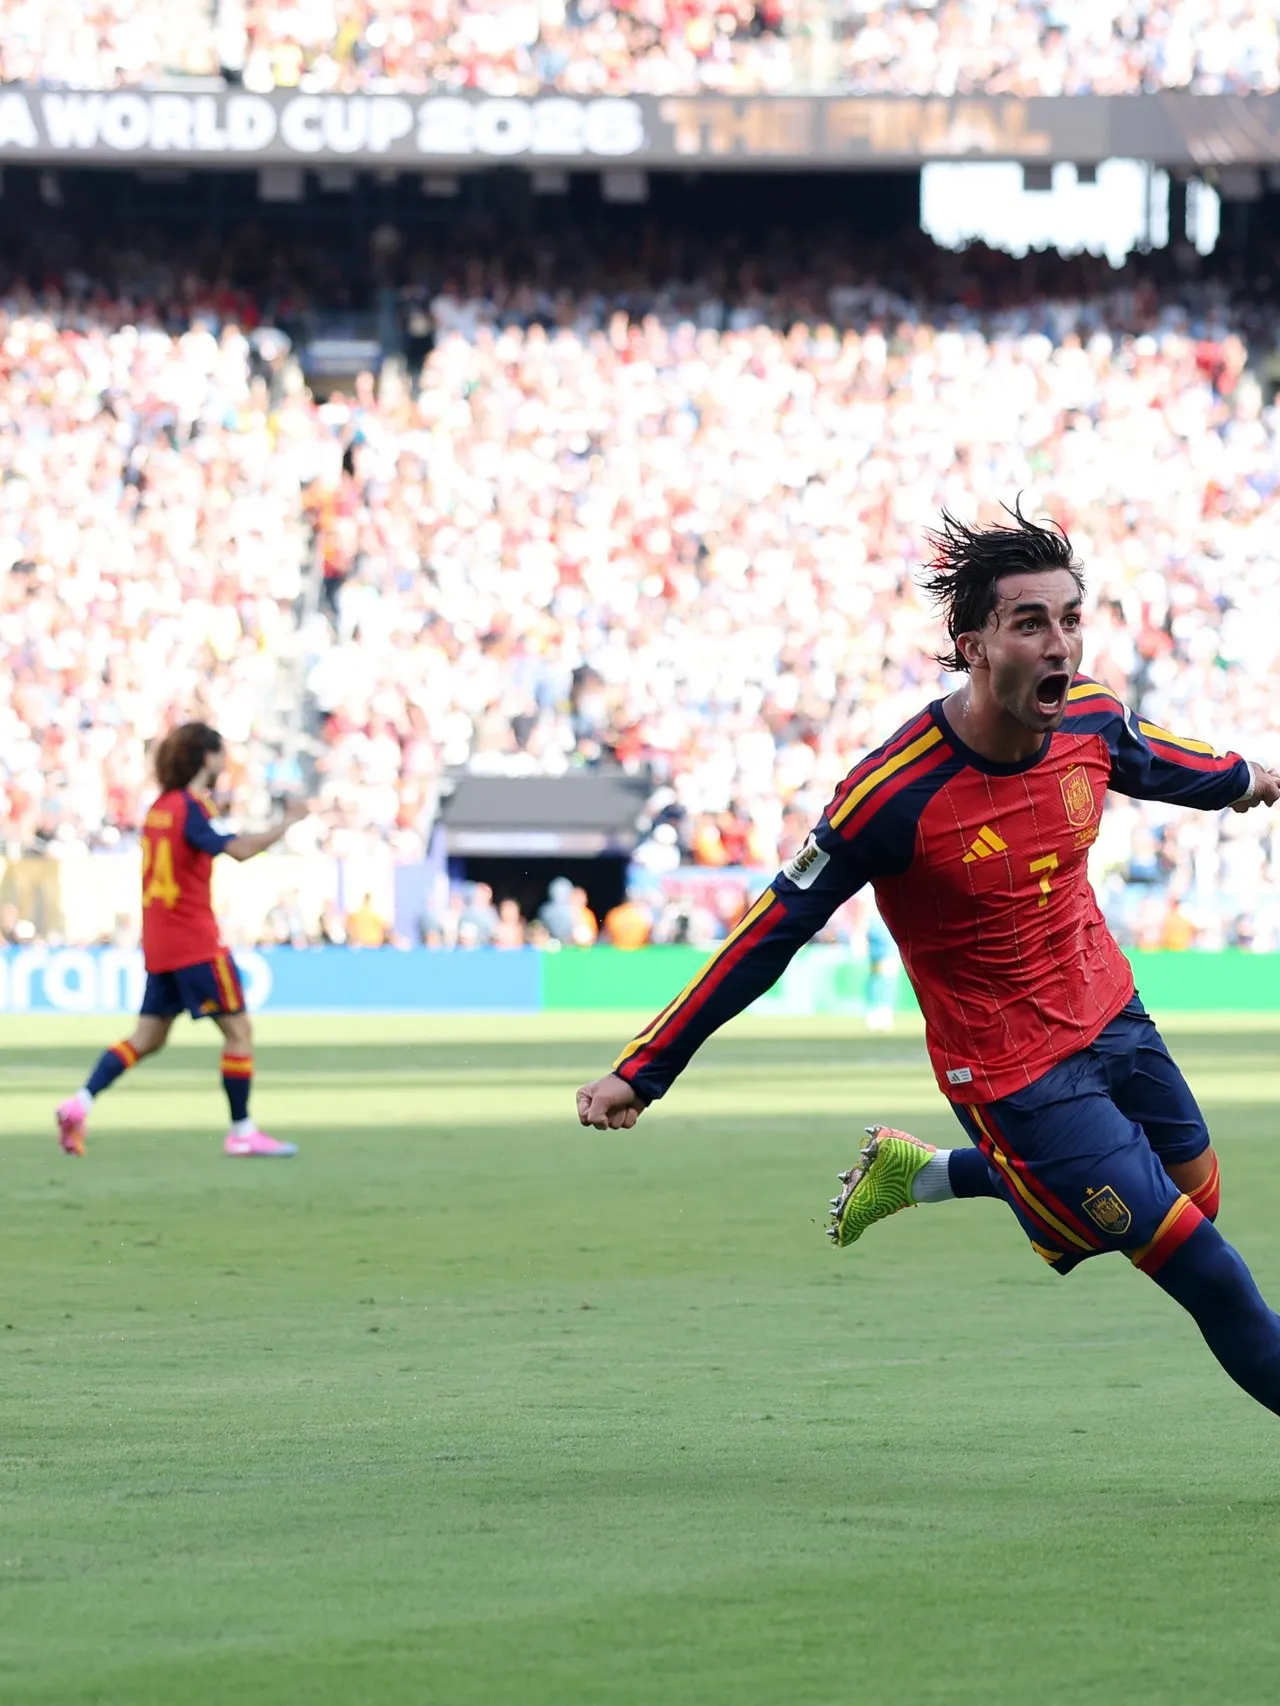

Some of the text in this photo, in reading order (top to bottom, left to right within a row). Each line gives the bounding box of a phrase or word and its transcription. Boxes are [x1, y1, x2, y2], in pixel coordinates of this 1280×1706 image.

[44, 96, 276, 151] WORLD
[281, 97, 413, 153] CUP
[415, 97, 645, 155] 2026
[661, 100, 1051, 155] THE FINAL
[1029, 852, 1059, 908] 7
